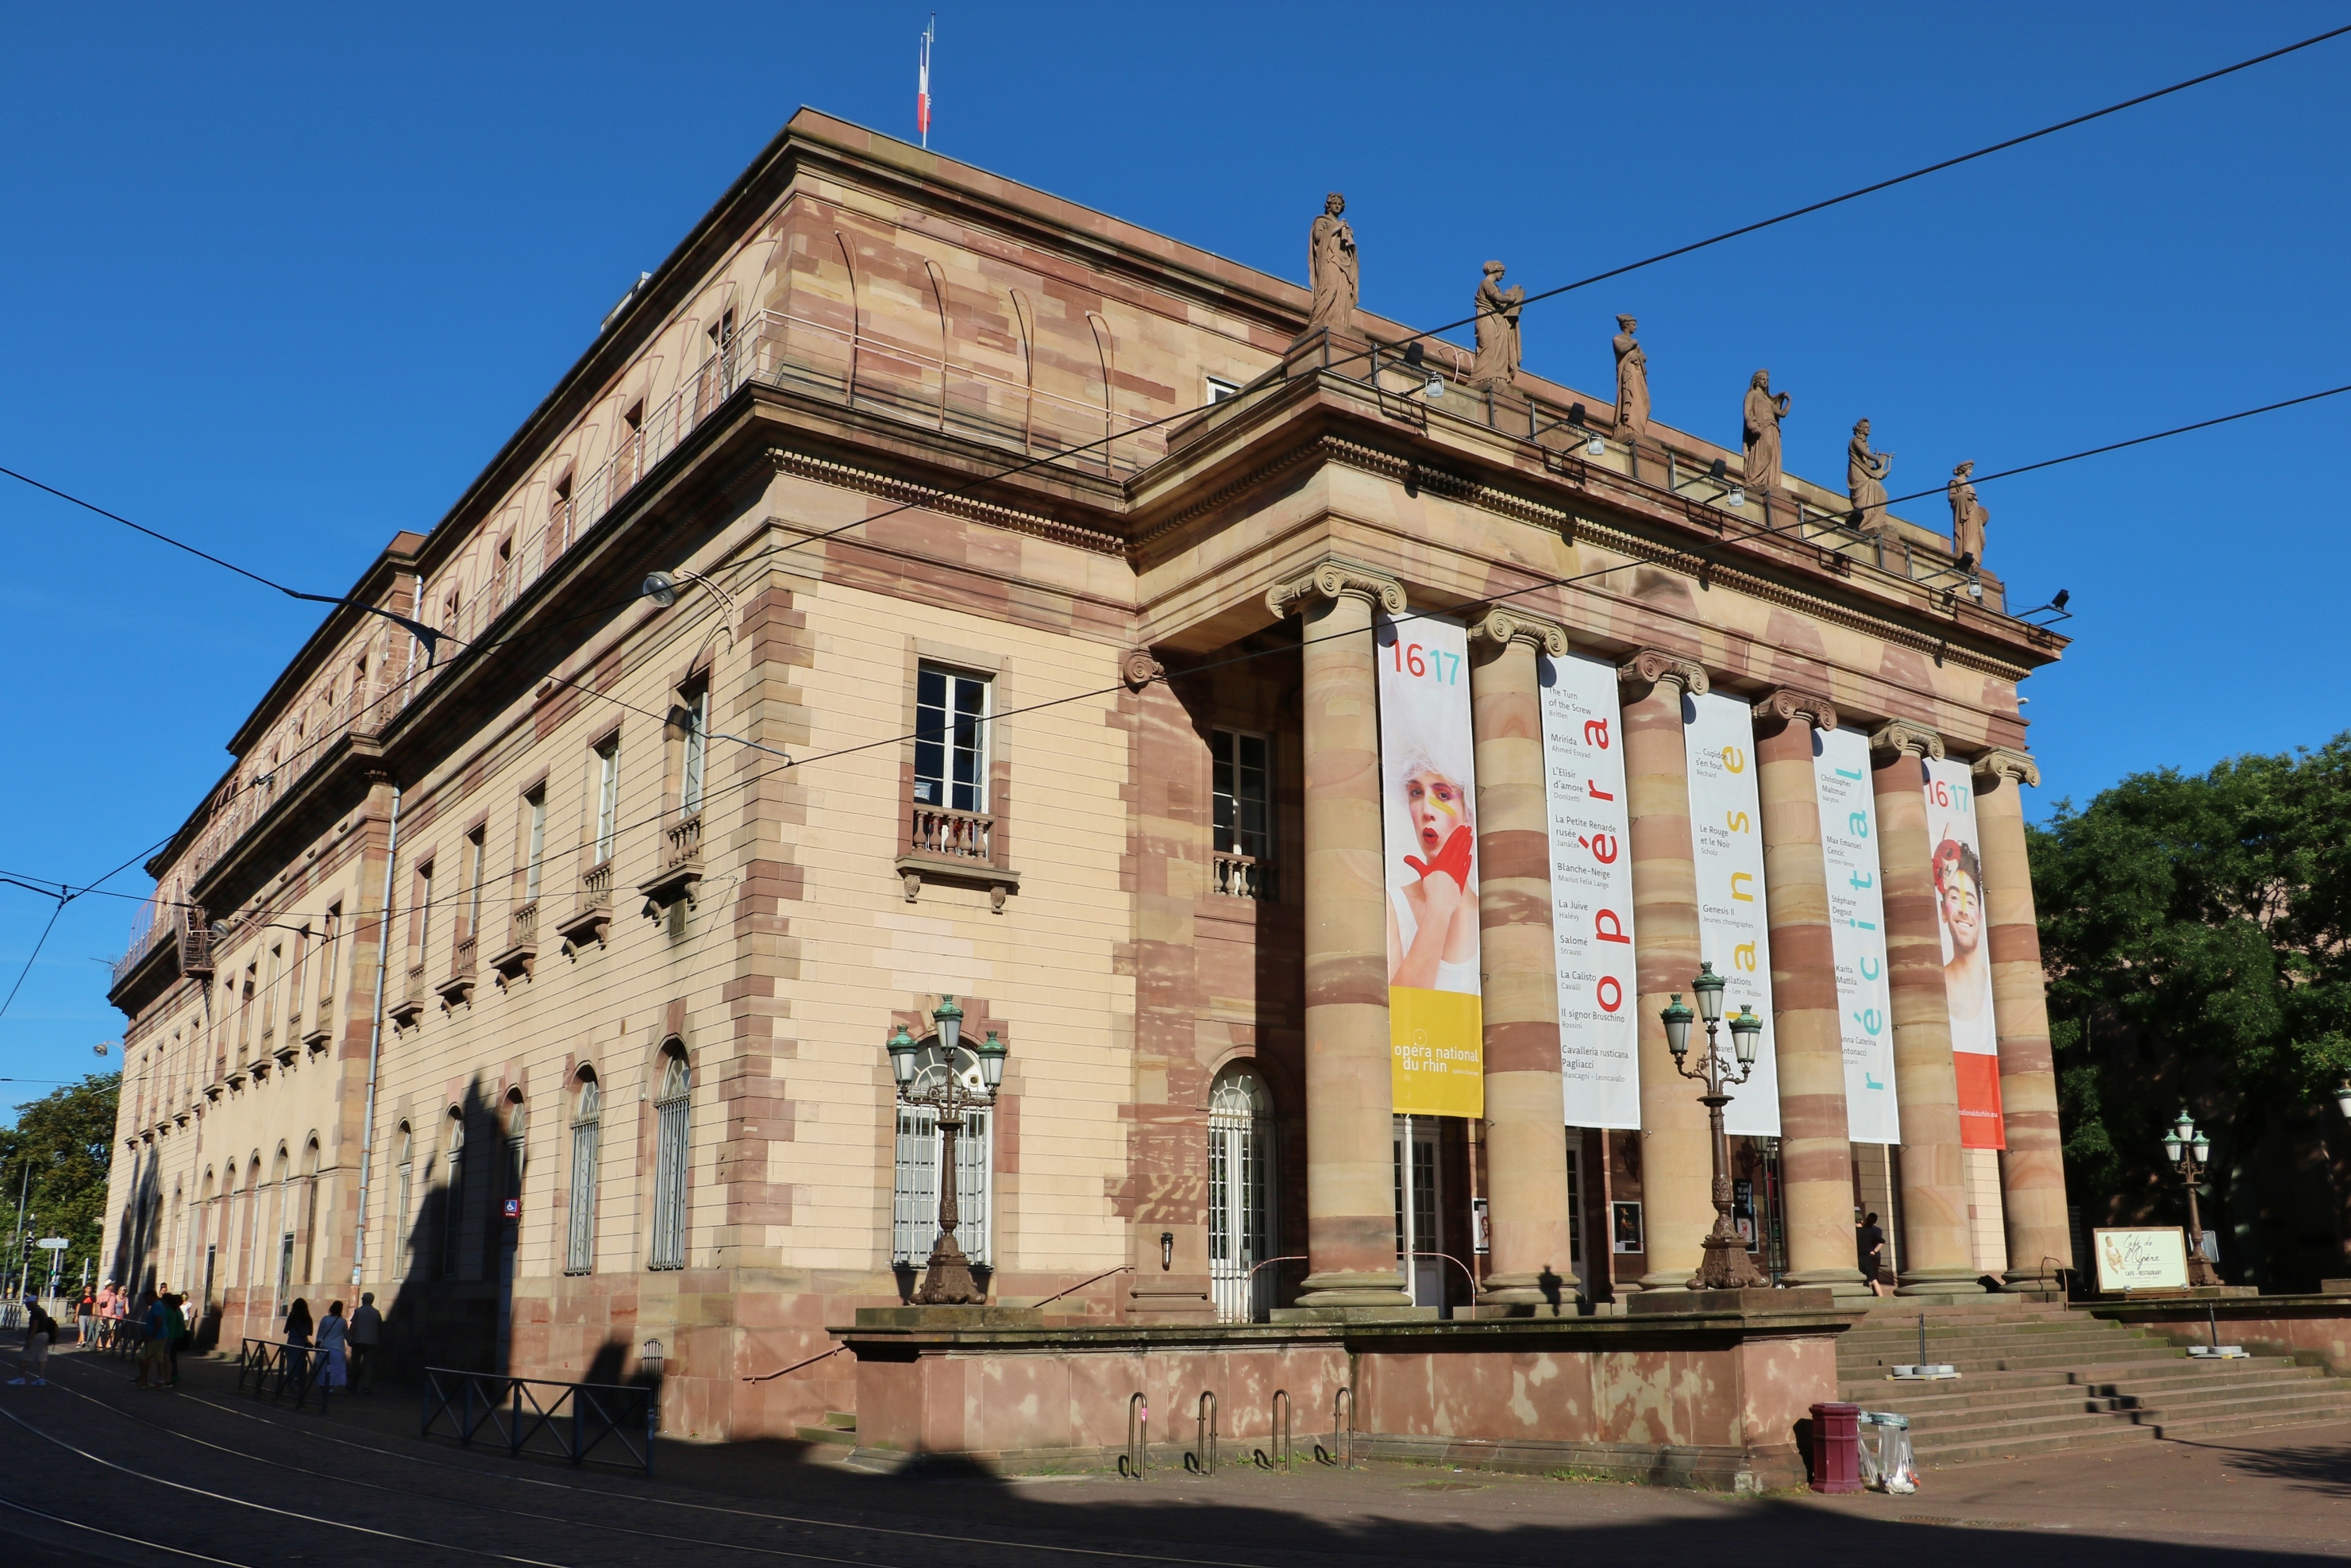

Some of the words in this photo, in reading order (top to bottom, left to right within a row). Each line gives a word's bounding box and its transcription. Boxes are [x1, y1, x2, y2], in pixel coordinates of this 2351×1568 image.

[1548, 686, 1561, 696] The
[1563, 690, 1578, 700] Turn
[1559, 701, 1570, 711] the
[1571, 703, 1592, 715] Screw
[1548, 710, 1568, 719] Britten
[1551, 734, 1578, 746] Mririda
[1551, 745, 1572, 755] Ahmed
[1573, 749, 1591, 759] Essyad
[1703, 748, 1728, 761] Cupidon
[1696, 758, 1708, 767] s'en
[1709, 761, 1723, 770] fout
[1697, 769, 1717, 779] Béchard
[1553, 780, 1584, 793] d'amore
[1821, 774, 1851, 788] Christopher
[1822, 784, 1847, 796] Maltman
[1554, 792, 1581, 803] Donizetti
[1823, 795, 1840, 804] baryton
[1555, 815, 1564, 824] La
[1567, 816, 1587, 827] Petite
[1589, 820, 1617, 834] Renarde
[1556, 828, 1577, 838] rusée
[1709, 826, 1729, 838] Rouge
[1709, 838, 1715, 846] le
[1717, 839, 1730, 849] Noir
[1827, 835, 1839, 845] Max
[1840, 838, 1862, 850] Emanuel
[1827, 846, 1845, 857] Cencic
[1828, 857, 1855, 868] contre-ténor
[1557, 862, 1611, 880] Blanche-Neige
[1558, 874, 1578, 884] Marius
[1579, 877, 1593, 887] Felix
[1594, 880, 1609, 890] Lange
[1559, 900, 1568, 909] La
[1571, 900, 1588, 911] Juive
[1832, 896, 1857, 907] Stéphane
[1703, 904, 1729, 915] Genesis
[1833, 906, 1852, 917] Degout
[1559, 911, 1580, 922] Halévy
[1703, 915, 1721, 924] Jeunes
[1722, 918, 1754, 929] chorégraphes
[1833, 917, 1850, 926] baryton
[1560, 934, 1588, 946] Salomé
[1560, 947, 1582, 957] Strauss
[1560, 969, 1570, 979] La
[1571, 971, 1597, 982] Calisto
[1836, 965, 1853, 974] Karita
[1561, 982, 1582, 991] Cavalli
[1836, 976, 1857, 985] Mattila
[1561, 1008, 1567, 1017] Il
[1568, 1010, 1591, 1021] signor
[1593, 1011, 1625, 1023] Bruschino
[1856, 1037, 1877, 1046] Caterina
[1394, 1042, 1432, 1060] opéra
[1436, 1046, 1478, 1062] national
[1562, 1045, 1598, 1057] Cavalleria
[1600, 1049, 1628, 1059] rusticana
[1842, 1048, 1867, 1057] ntonacci
[1403, 1057, 1419, 1070] du
[1423, 1058, 1447, 1073] rhin
[1562, 1058, 1594, 1070] Pagliacci
[1563, 1071, 1590, 1082] Mascagni
[1595, 1073, 1625, 1083] Leoncavallo
[2123, 1234, 2141, 1249] Café
[2145, 1236, 2153, 1246] de
